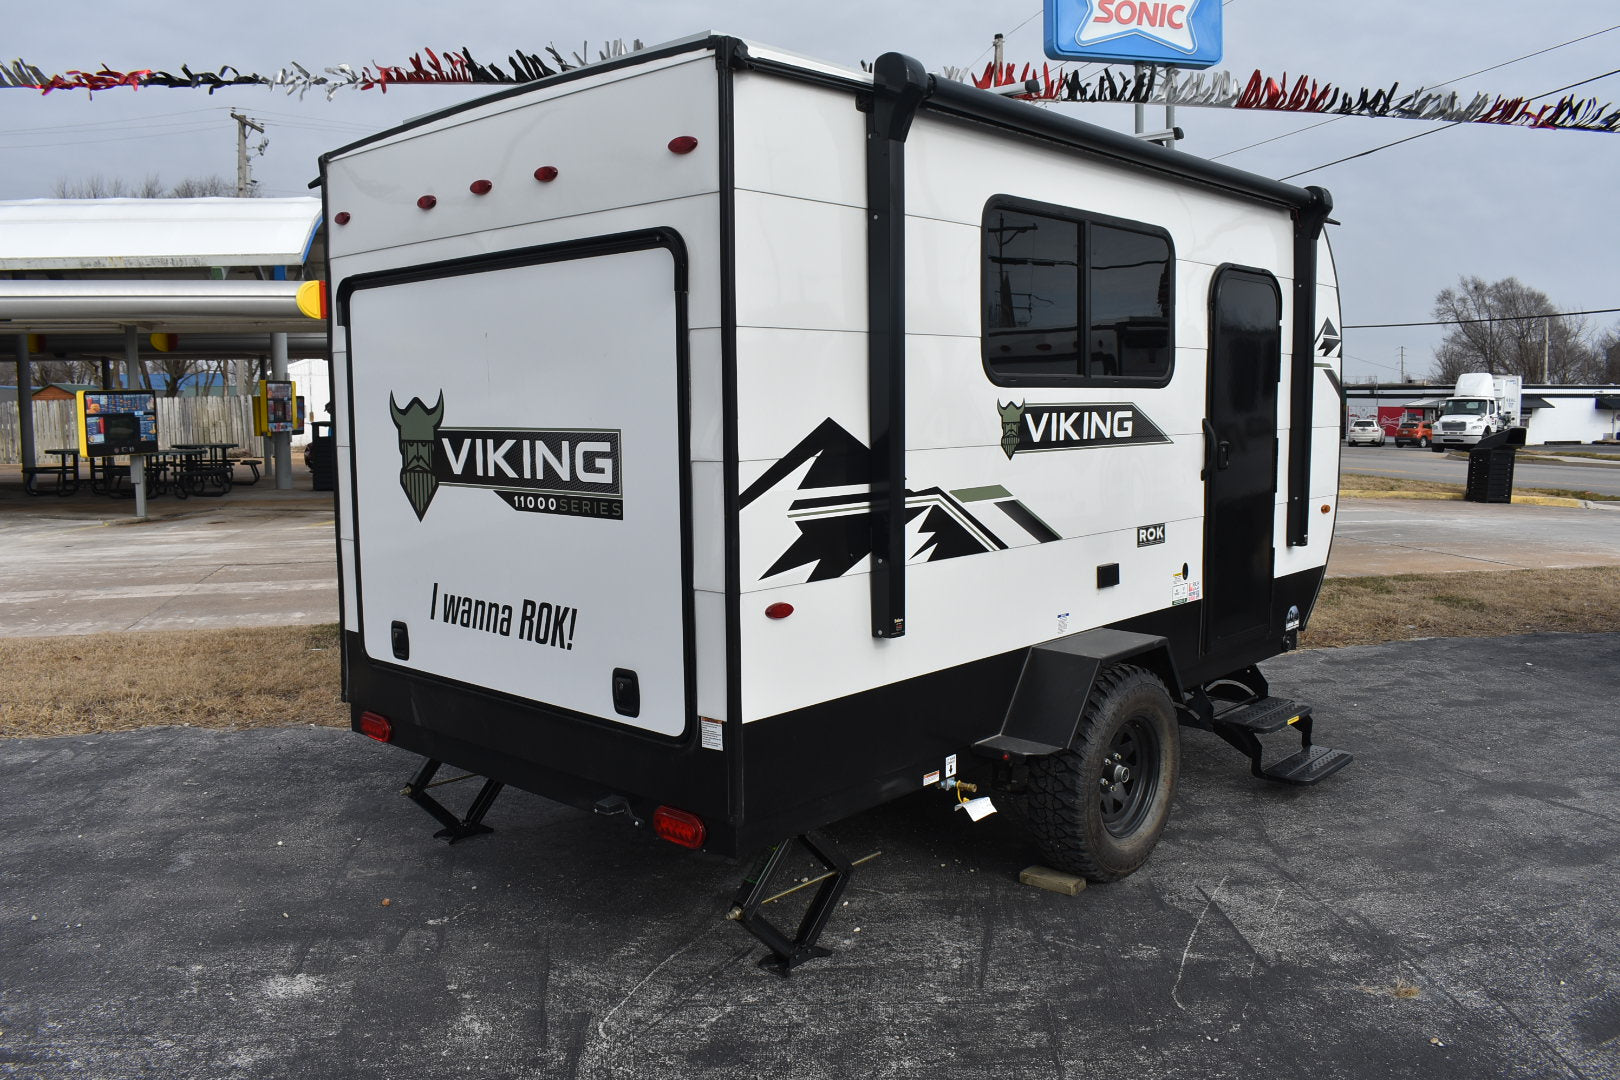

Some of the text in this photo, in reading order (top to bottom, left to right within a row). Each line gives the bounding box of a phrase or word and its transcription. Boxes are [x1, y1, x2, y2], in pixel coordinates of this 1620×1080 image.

[1093, 0, 1186, 29] SONIC
[1025, 410, 1133, 443] VIKING
[441, 438, 613, 484] VIKING
[1139, 526, 1164, 543] ROK
[430, 583, 578, 651] I wanna ROK!
